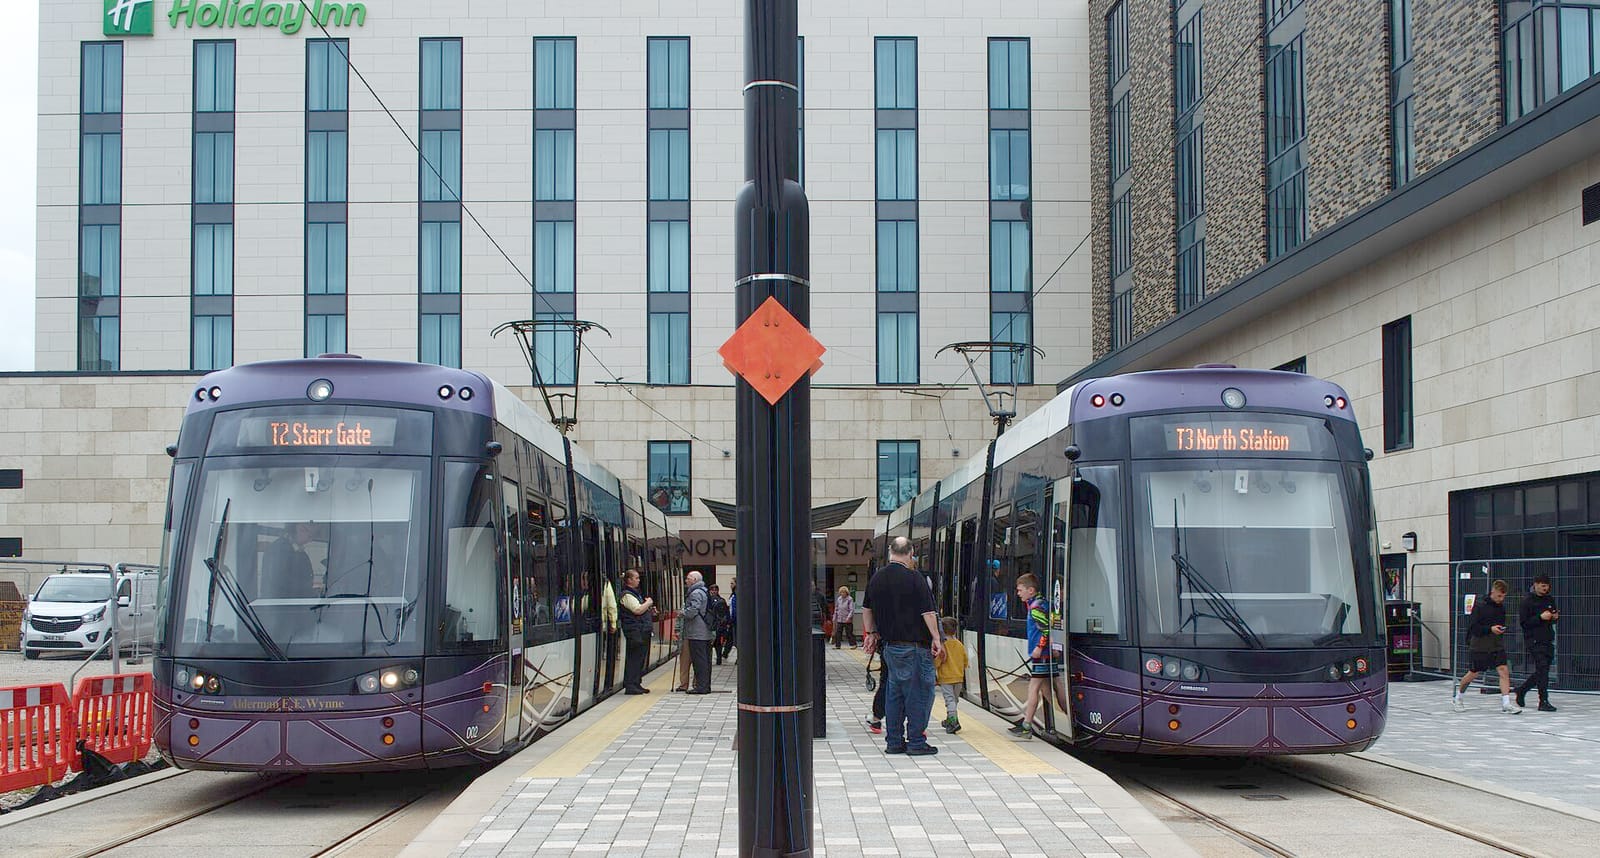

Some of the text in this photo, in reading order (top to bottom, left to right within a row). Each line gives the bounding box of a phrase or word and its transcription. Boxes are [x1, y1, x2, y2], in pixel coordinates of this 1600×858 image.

[168, 0, 366, 35] Holiday Inn
[271, 422, 371, 445] T2 Starr Gate
[1177, 428, 1289, 451] T3 North Station
[306, 699, 345, 711] Wynne
[1090, 712, 1102, 725] 008
[466, 725, 478, 739] 002
